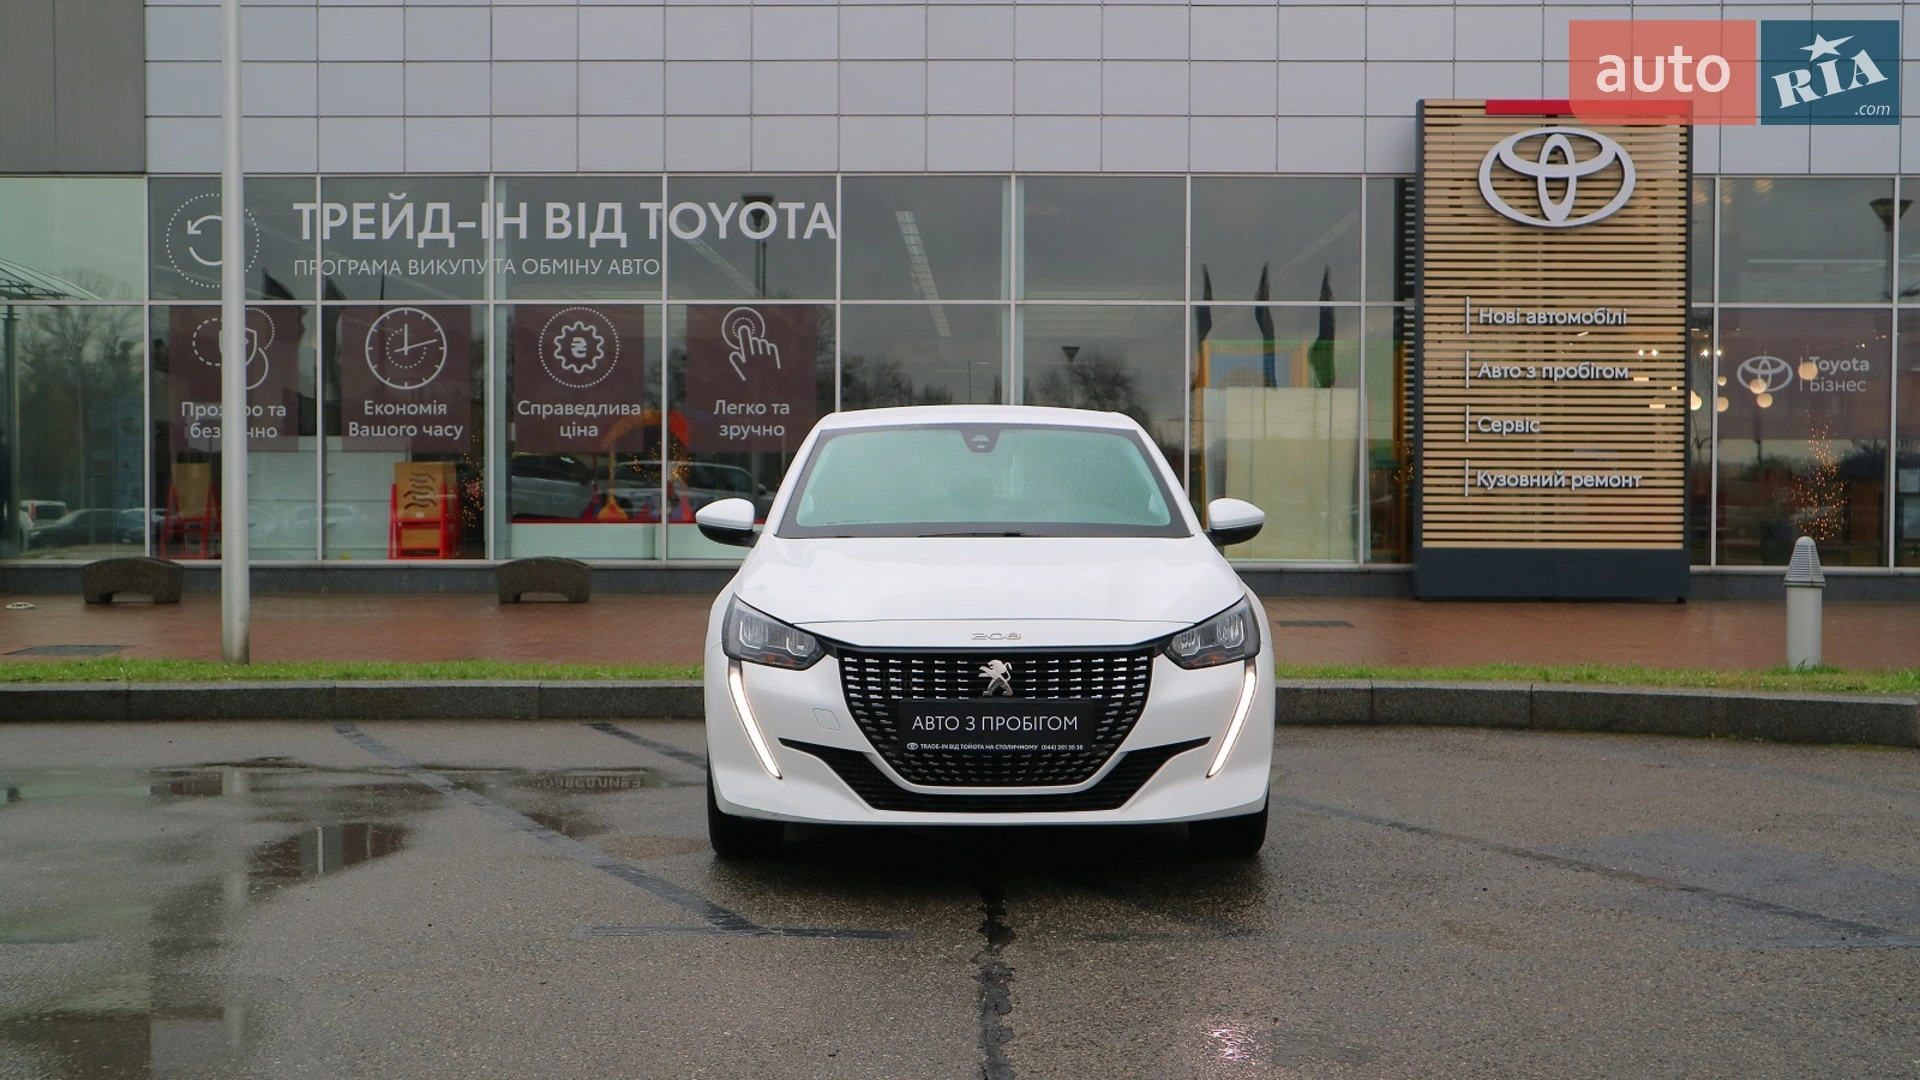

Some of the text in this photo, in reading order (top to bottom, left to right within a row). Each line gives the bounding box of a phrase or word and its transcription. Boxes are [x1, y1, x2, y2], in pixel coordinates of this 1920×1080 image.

[293, 193, 837, 248] ТРЕЙД-ІН ВІД TOYOTA
[294, 258, 660, 276] ПРОГРАМА ВИКУПУ ТА ОБМІНУ АВТО
[1479, 307, 1628, 325] Нові автомобілі
[1477, 362, 1630, 382] Авто з пробігом
[1809, 356, 1870, 374] Toyota
[1810, 377, 1867, 392] Бізнес
[268, 405, 287, 417] та
[364, 400, 448, 415] Економія
[517, 400, 641, 419] Справедлива
[713, 400, 790, 415] Легко та
[348, 421, 464, 440] Вашого часу
[560, 421, 599, 439] ціна
[719, 425, 785, 440] зручно
[1477, 416, 1541, 436] Сервіс
[1476, 470, 1643, 491] Кузовний ремонт
[971, 632, 1022, 640] 208
[912, 715, 1078, 731] АВТО З ПРОБІГОМ
